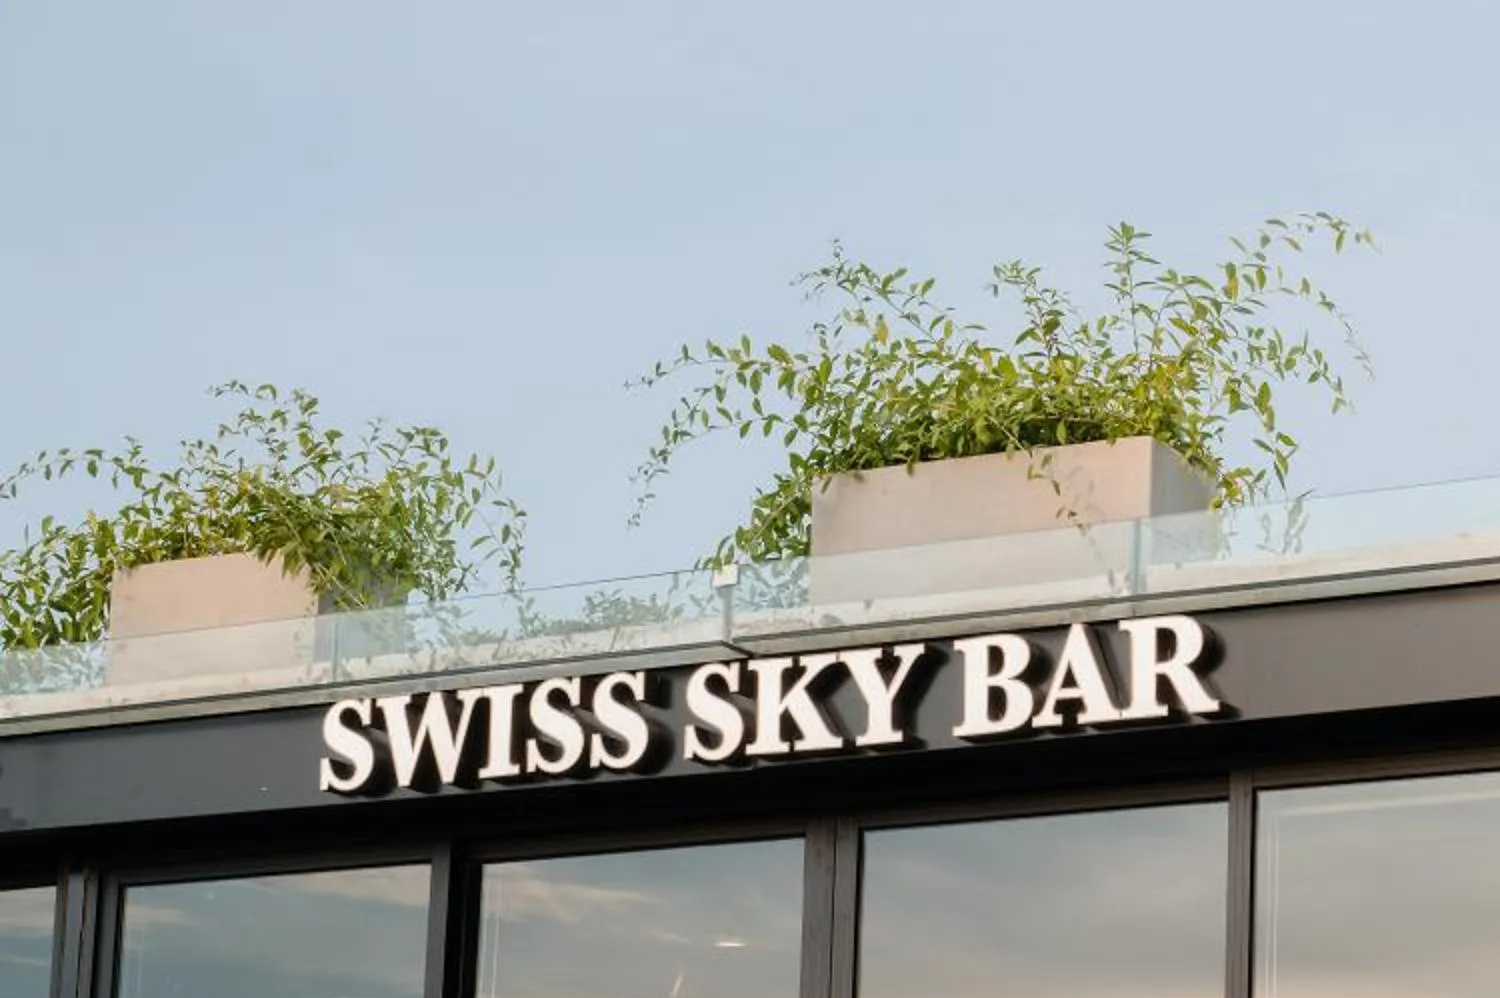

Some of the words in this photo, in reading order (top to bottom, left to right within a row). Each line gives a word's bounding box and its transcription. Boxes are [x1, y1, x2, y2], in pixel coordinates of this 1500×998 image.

[319, 671, 650, 792] SWISS
[683, 643, 926, 762] SKY
[951, 614, 1220, 737] BAR
